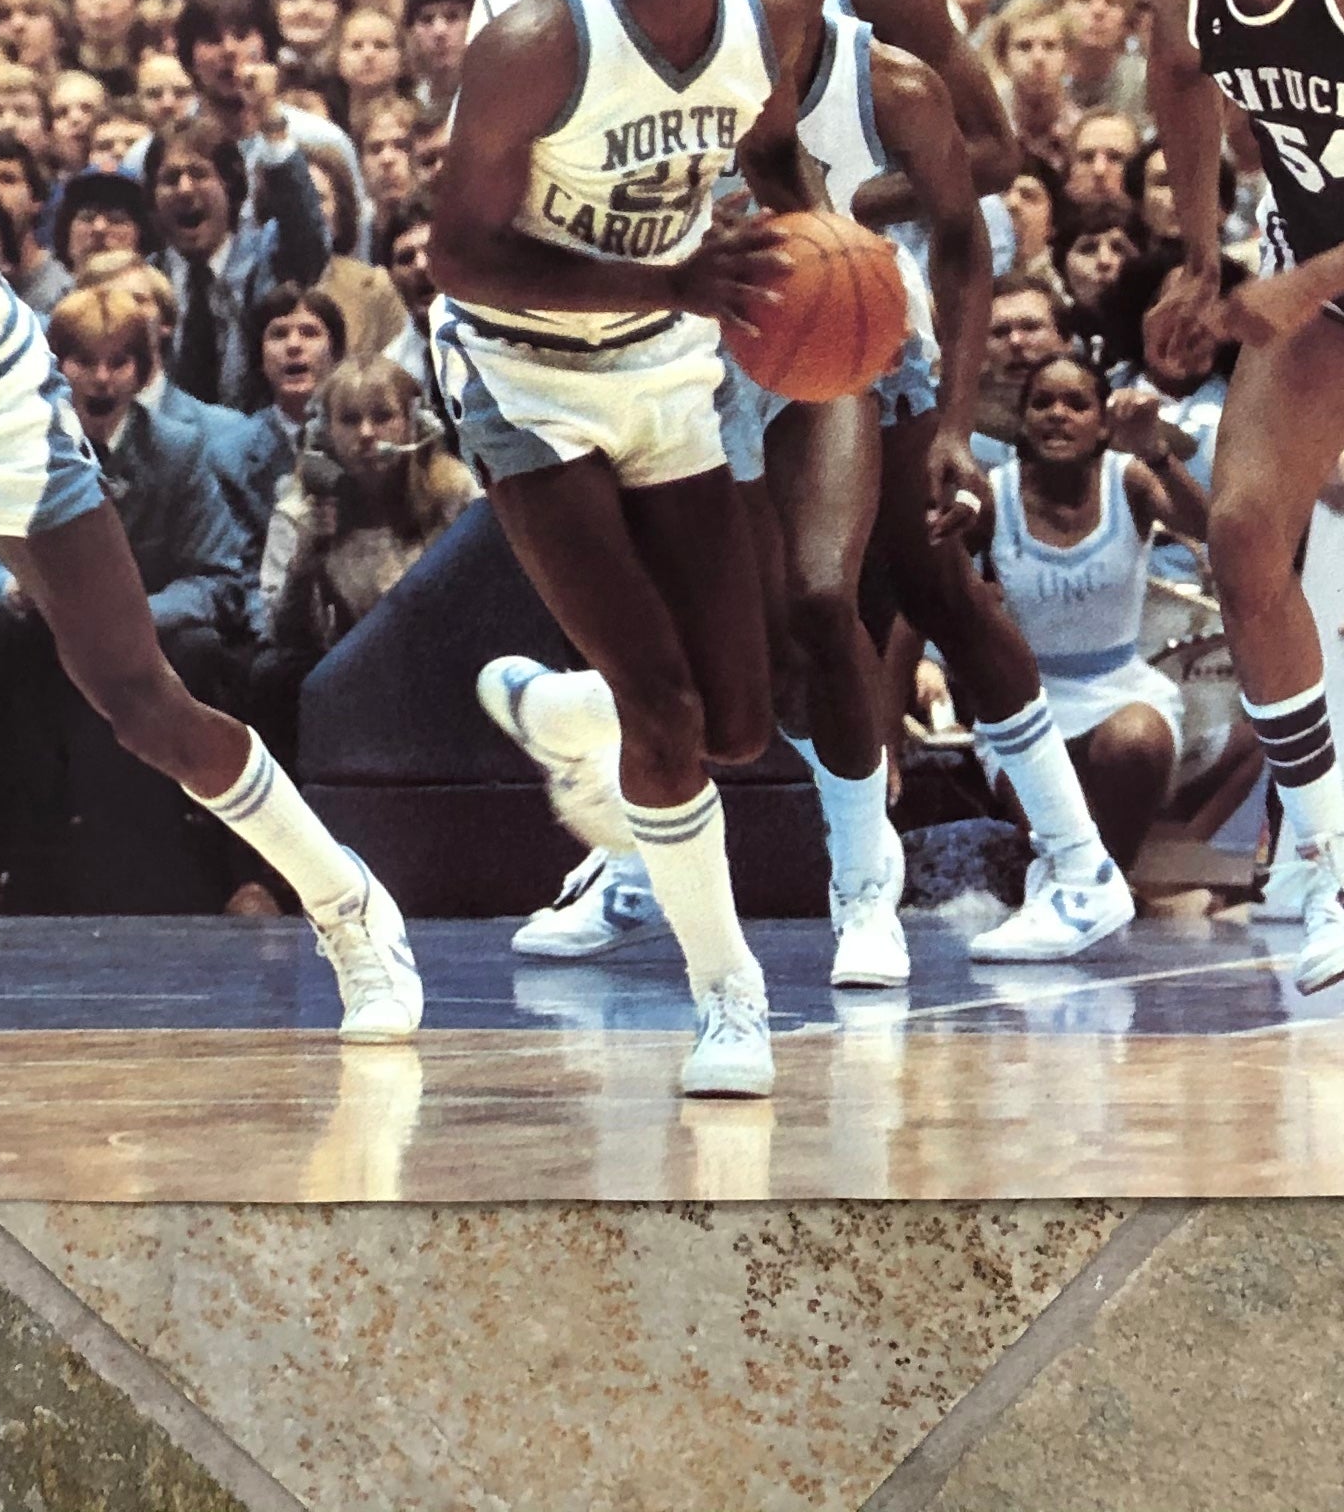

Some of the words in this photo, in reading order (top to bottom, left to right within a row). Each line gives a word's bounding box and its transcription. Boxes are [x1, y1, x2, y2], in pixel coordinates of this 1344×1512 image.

[601, 105, 737, 172] NORTH
[543, 183, 685, 258] CAROL
[1036, 561, 1106, 604] UNC
